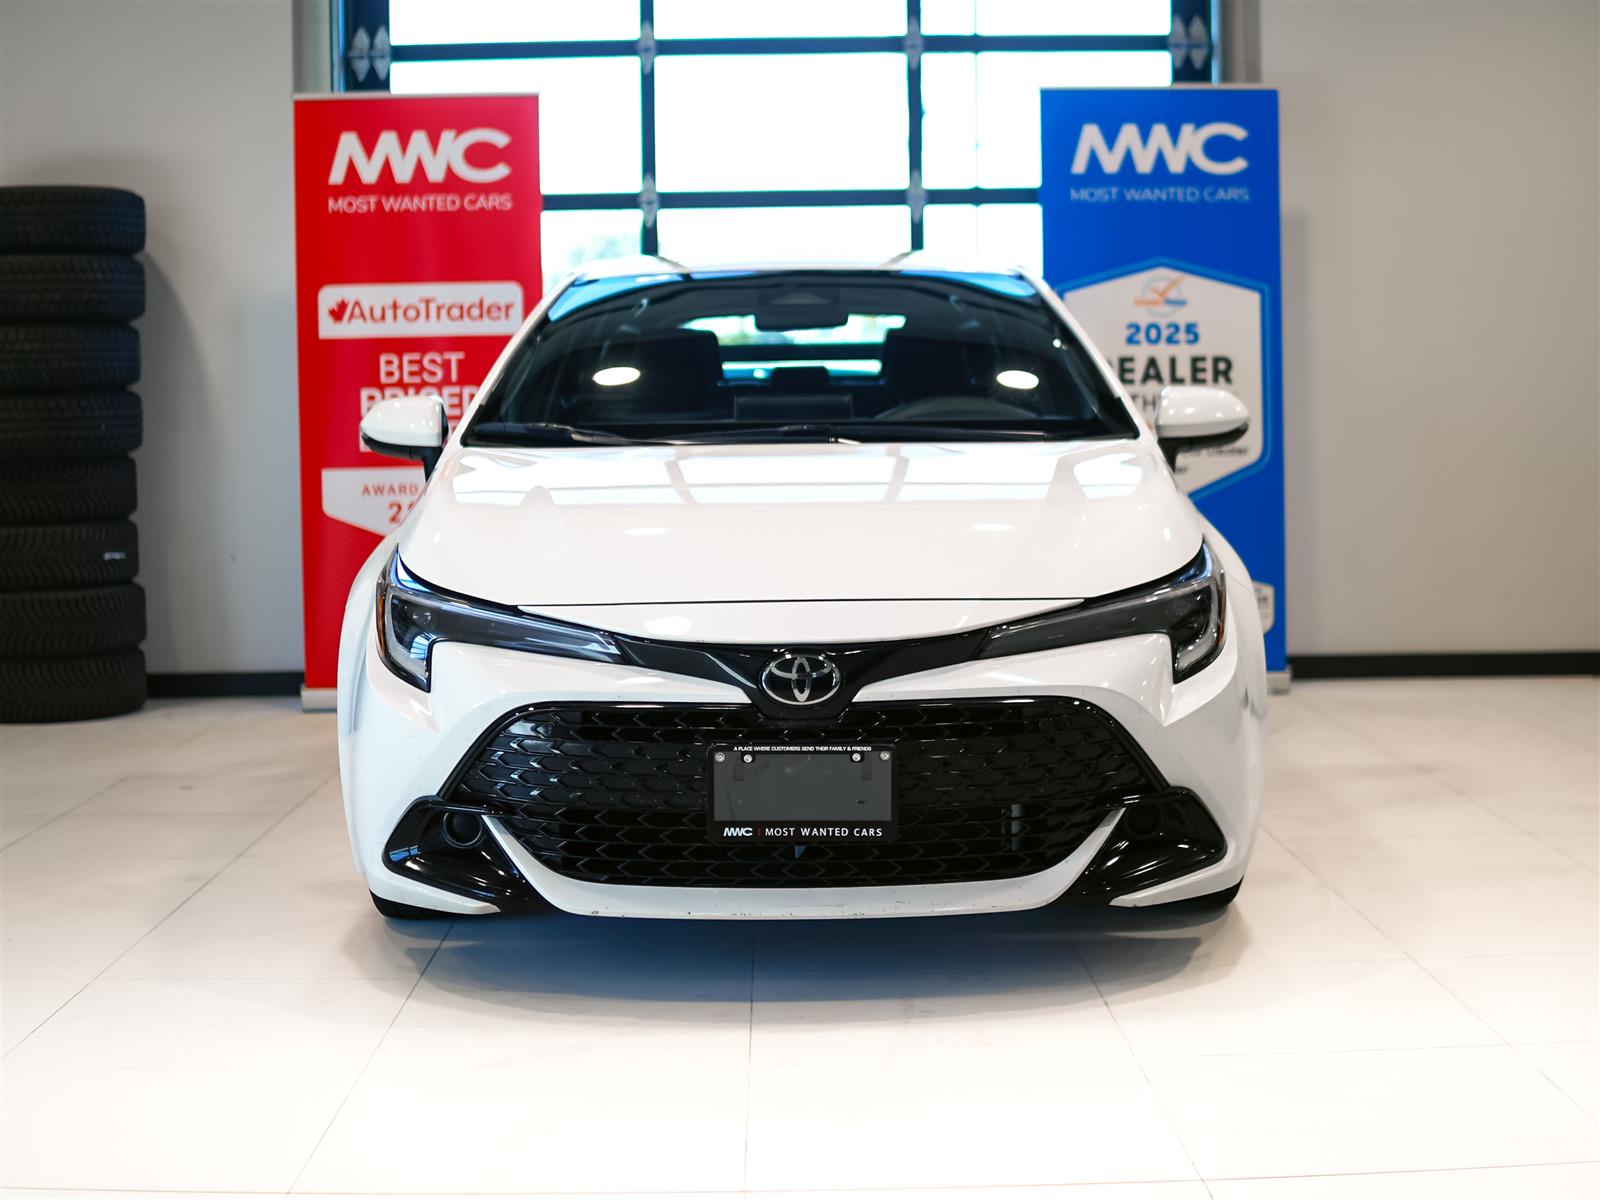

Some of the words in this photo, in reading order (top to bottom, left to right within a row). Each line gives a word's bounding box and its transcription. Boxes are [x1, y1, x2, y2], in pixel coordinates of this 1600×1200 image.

[328, 127, 512, 185] MWC
[1070, 122, 1249, 175] MWC
[328, 195, 377, 214] MOST
[381, 194, 460, 213] WANTED
[463, 192, 513, 211] CARS
[1070, 186, 1118, 202] MOST
[1123, 186, 1199, 202] WANTED
[1203, 185, 1249, 202] CARS
[348, 296, 514, 323] AutoTrader
[1125, 322, 1200, 345] 2025
[379, 351, 465, 384] BEST
[1107, 355, 1233, 385] EALER
[723, 827, 753, 837] MWC
[765, 827, 796, 837] MOST
[800, 827, 849, 837] WANTED
[853, 828, 883, 837] CARS
